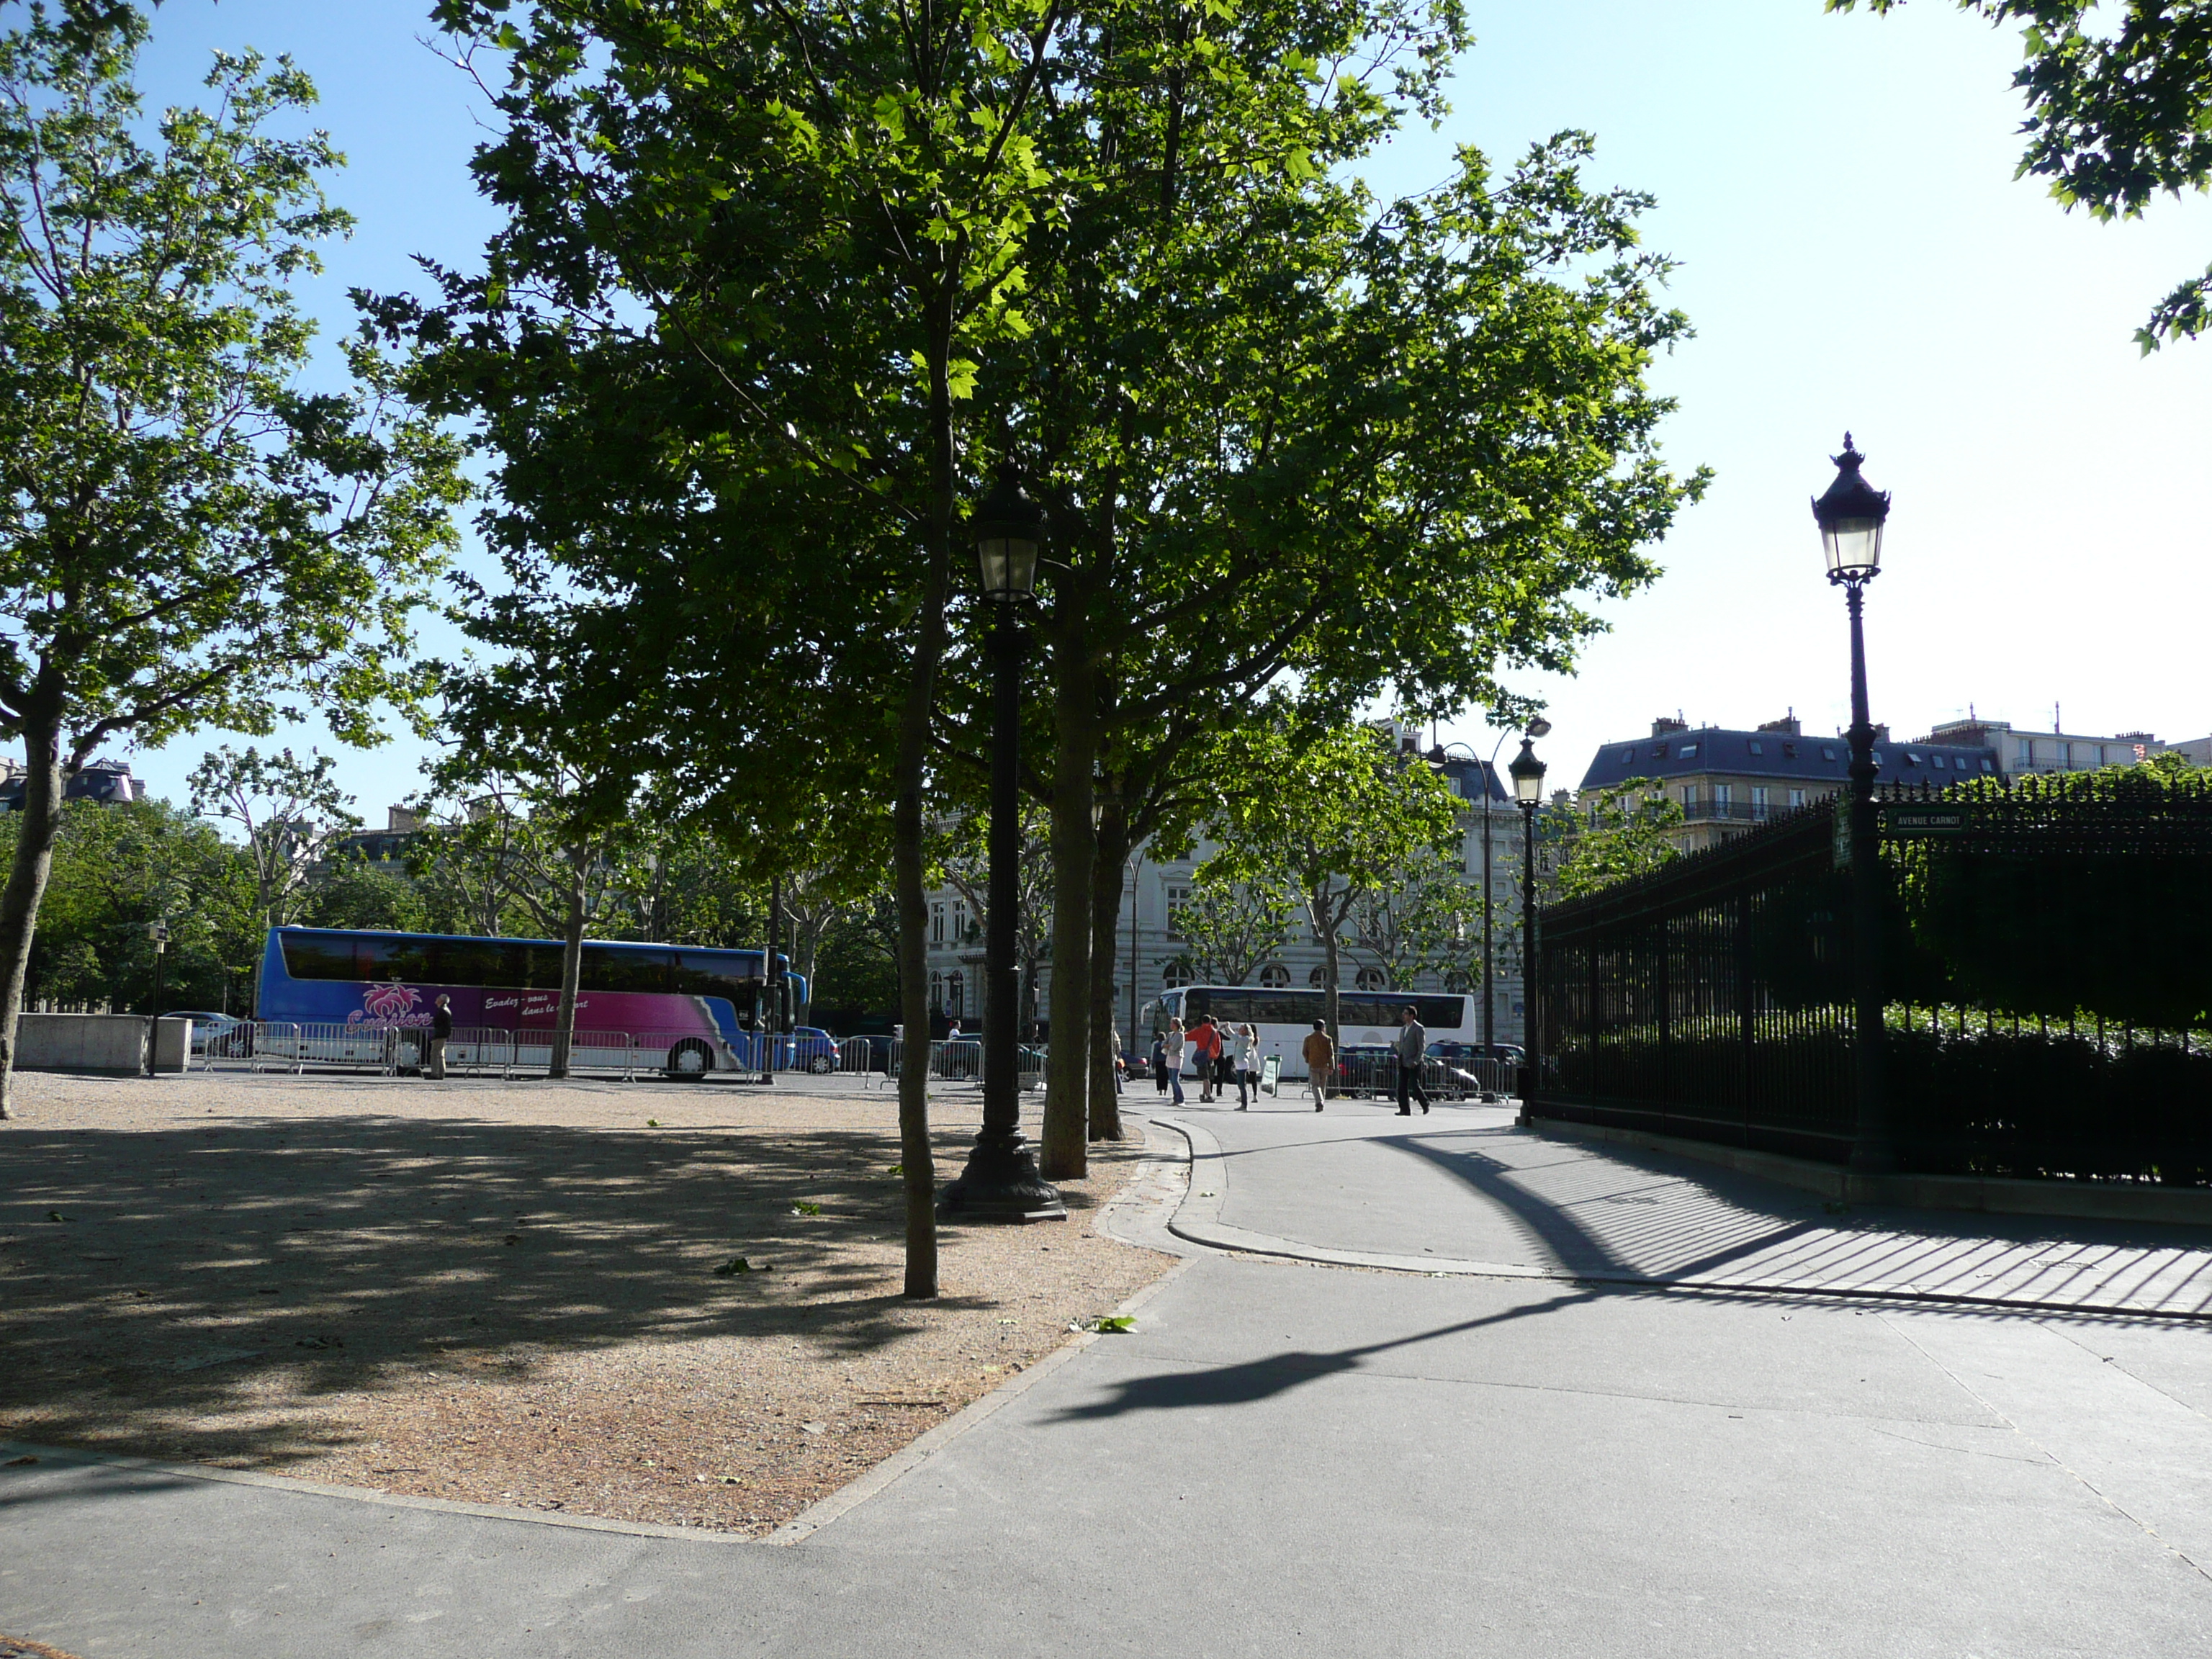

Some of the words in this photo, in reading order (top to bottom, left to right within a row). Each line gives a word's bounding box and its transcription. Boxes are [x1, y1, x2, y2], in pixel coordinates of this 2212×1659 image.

[1897, 816, 1928, 825] AVENUE
[1930, 816, 1961, 825] CARNOT
[485, 997, 519, 1010] Evadez
[522, 1005, 544, 1016] dans
[546, 1003, 555, 1012] le
[346, 1010, 433, 1034] Evasion
